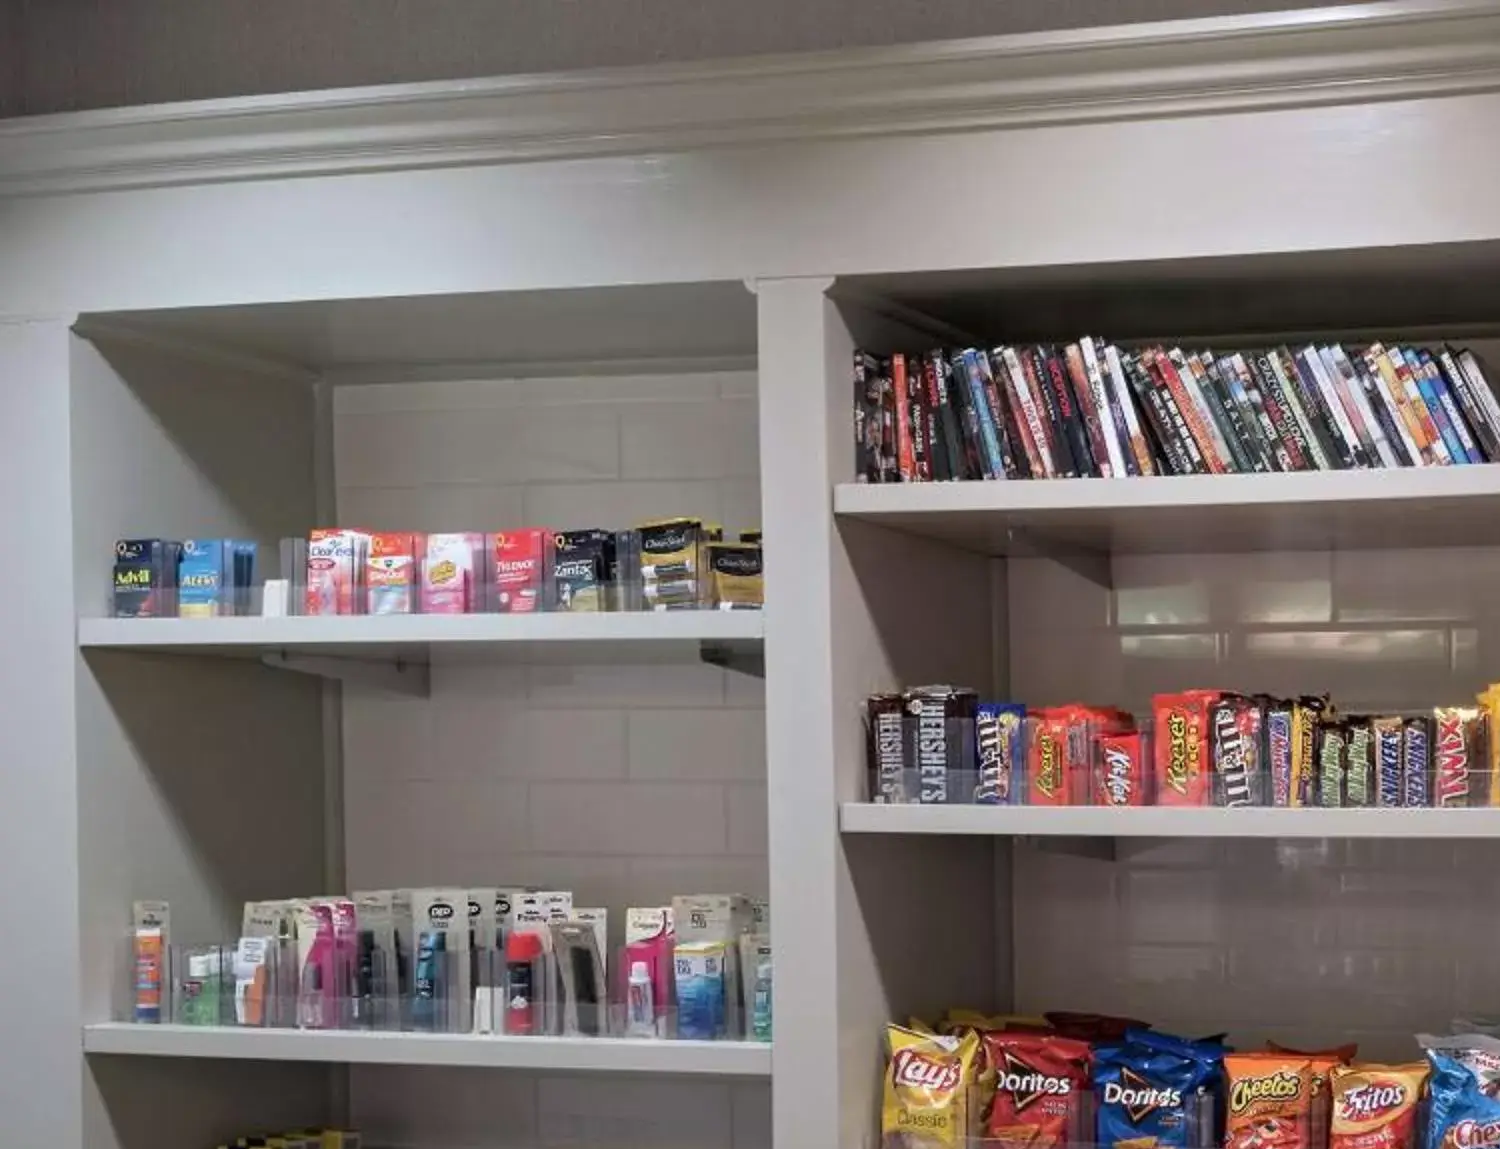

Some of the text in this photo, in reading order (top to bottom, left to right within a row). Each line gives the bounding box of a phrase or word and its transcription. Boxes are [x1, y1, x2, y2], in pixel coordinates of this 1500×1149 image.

[115, 569, 151, 585] Advil
[879, 712, 903, 795] HERSHEY'S
[919, 703, 947, 802] HERSHEY'S
[1378, 731, 1401, 806] SNICKERS
[895, 1050, 962, 1087] Lay's
[1104, 1081, 1182, 1106] Doritos
[1230, 1072, 1299, 1112] Cheetos
[1343, 1086, 1405, 1118] Fritos
